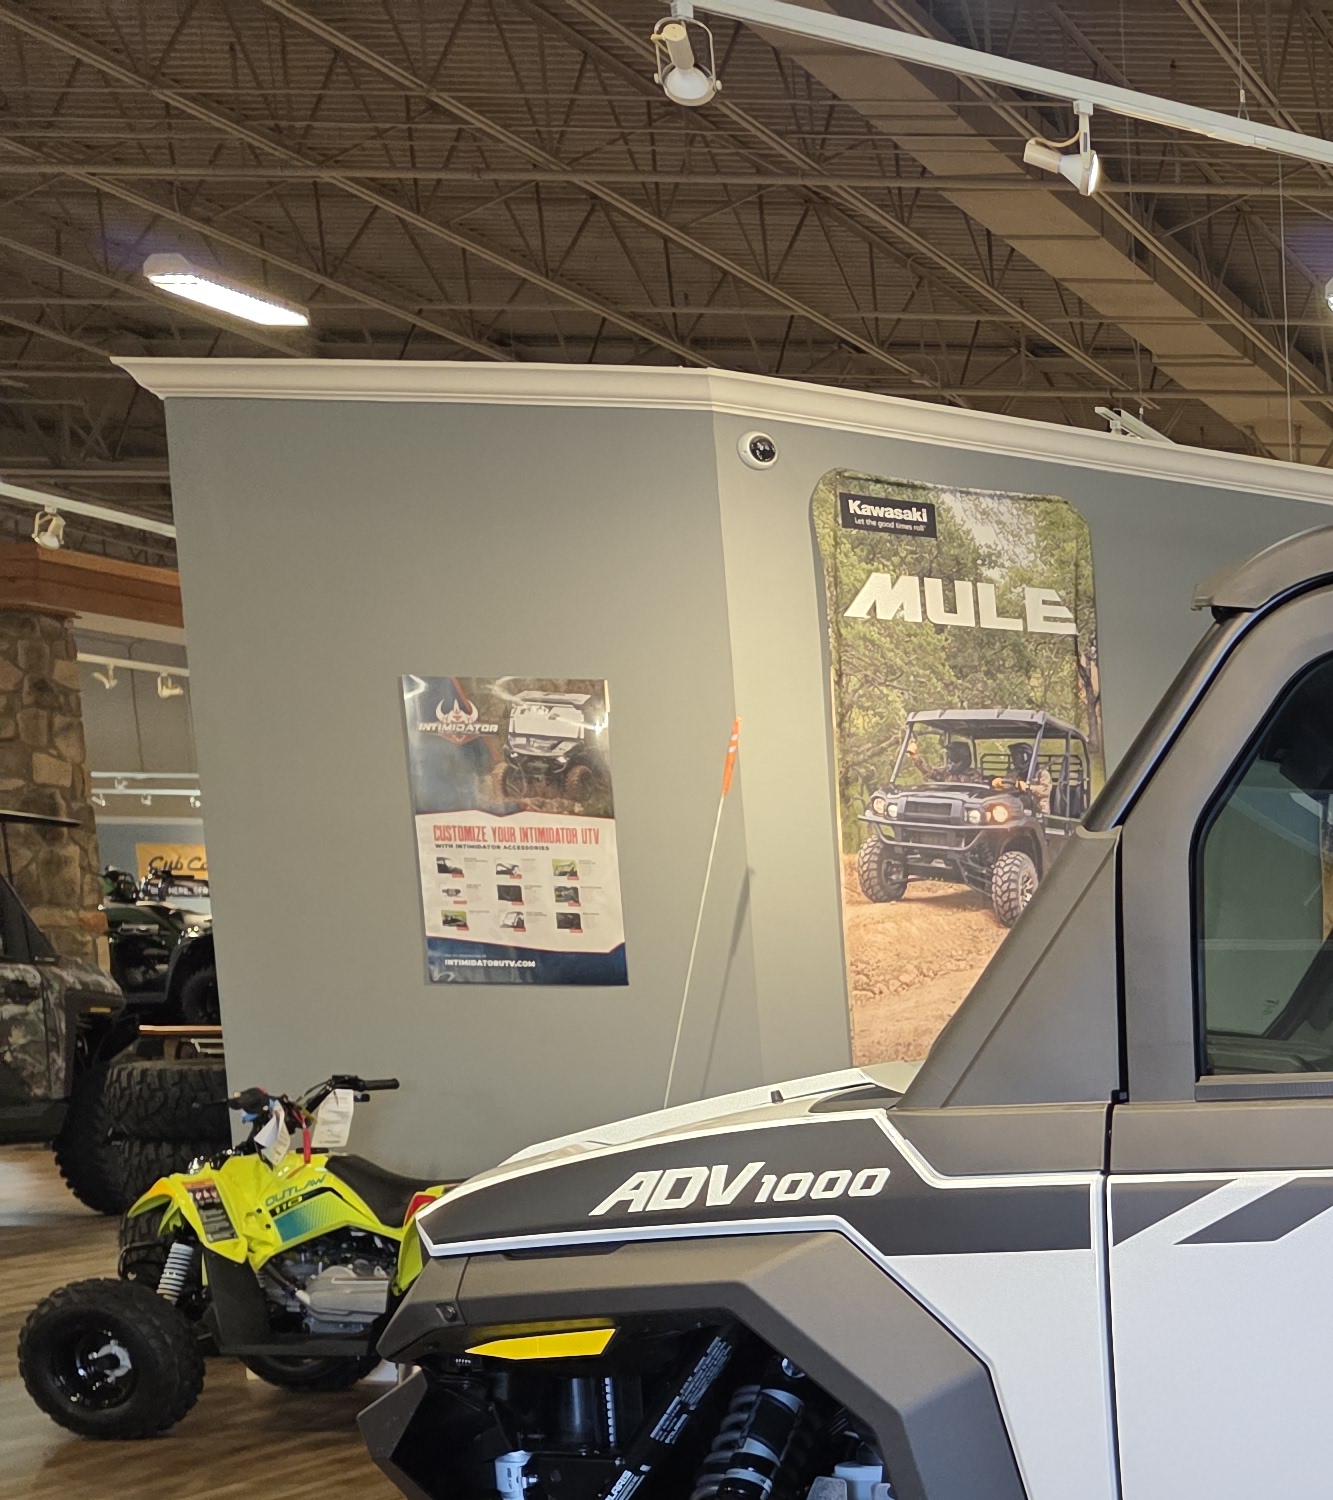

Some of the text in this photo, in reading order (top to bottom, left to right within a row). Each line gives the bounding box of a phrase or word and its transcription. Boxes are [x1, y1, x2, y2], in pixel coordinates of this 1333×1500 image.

[848, 499, 928, 523] Kawasaki
[854, 517, 925, 532] Let the good times roll
[844, 572, 1080, 636] MULE
[418, 721, 499, 733] INTIMIDATOR
[433, 825, 600, 845] CUSTOMIZE YOUR INTIMIDATOR UTV
[148, 855, 184, 872] Cub
[444, 959, 536, 968] INTIMIDATORUTV.COM
[265, 1174, 326, 1207] OUTLAW
